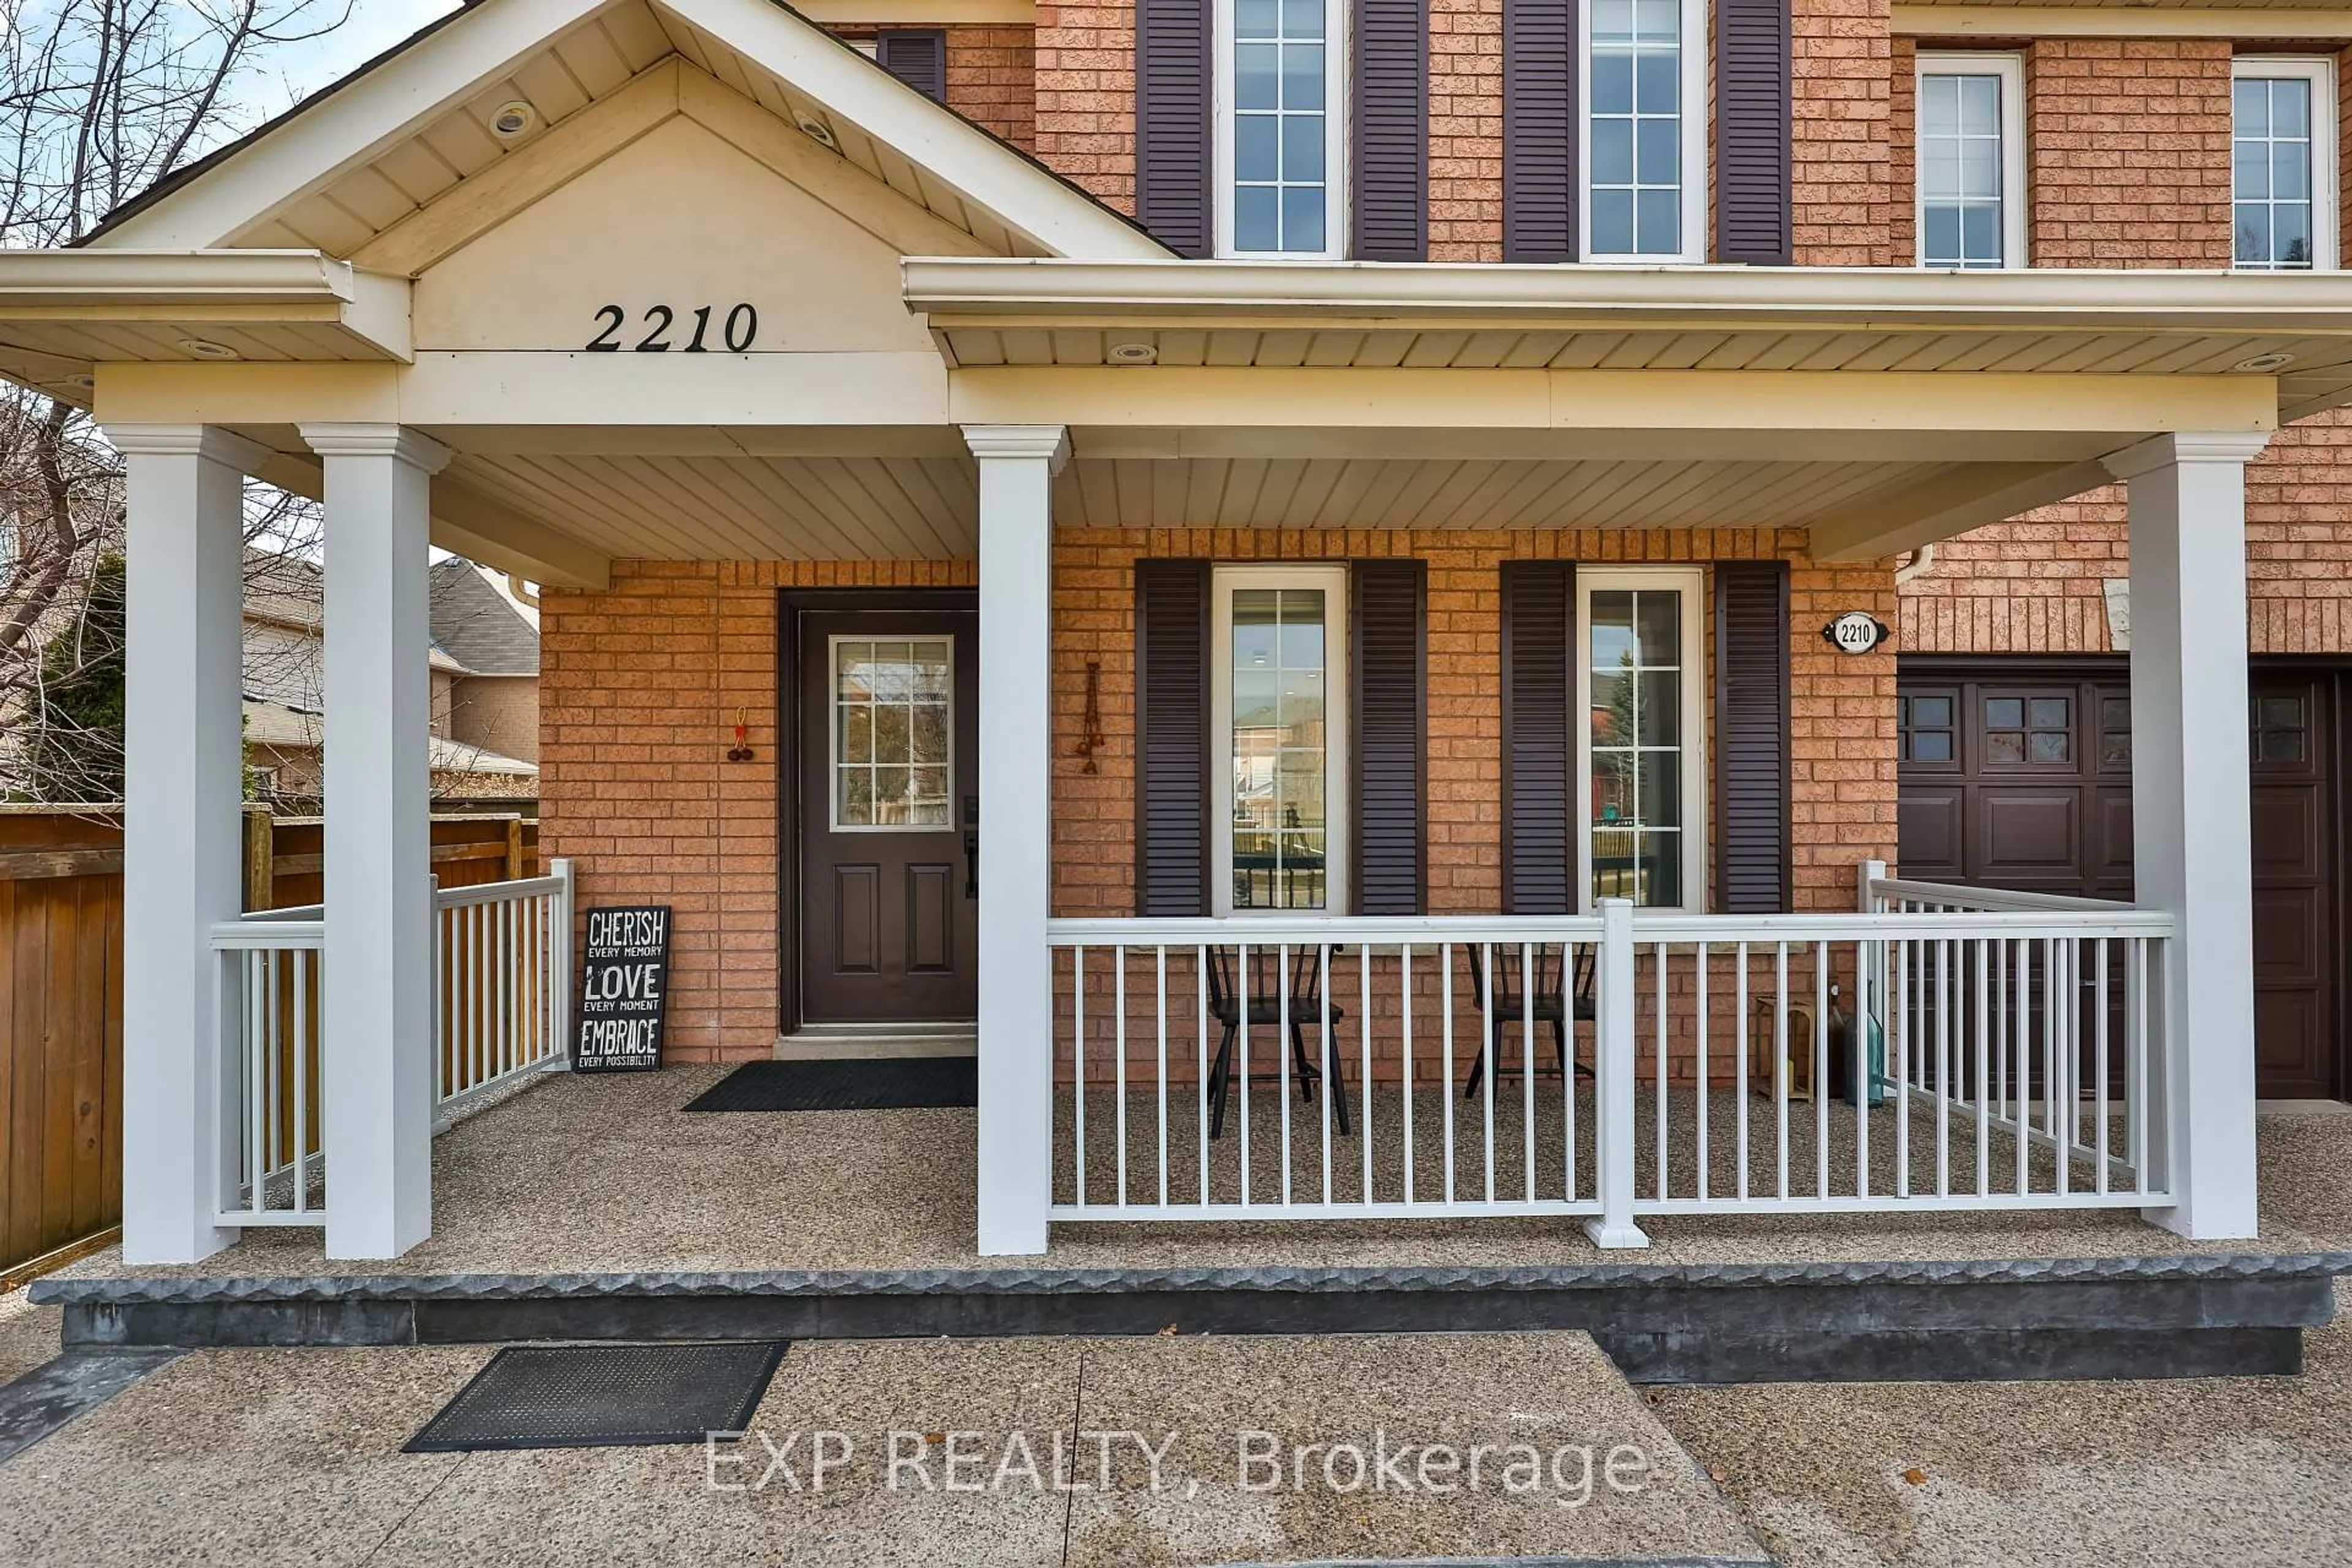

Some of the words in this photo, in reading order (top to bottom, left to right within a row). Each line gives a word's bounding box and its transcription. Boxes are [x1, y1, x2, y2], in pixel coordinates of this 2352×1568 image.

[586, 303, 757, 353] 2210
[1842, 624, 1870, 643] 2210
[589, 911, 665, 946] CHERISH
[589, 948, 620, 958] EVERY
[624, 945, 663, 957] MEMORY
[585, 963, 661, 1000] LOVE
[584, 1001, 616, 1012] EVERY
[620, 1000, 660, 1011] MOMENT
[580, 1019, 658, 1056] EMBRACE
[579, 1057, 603, 1068] EVERY
[606, 1055, 657, 1066] POSSIBILITY
